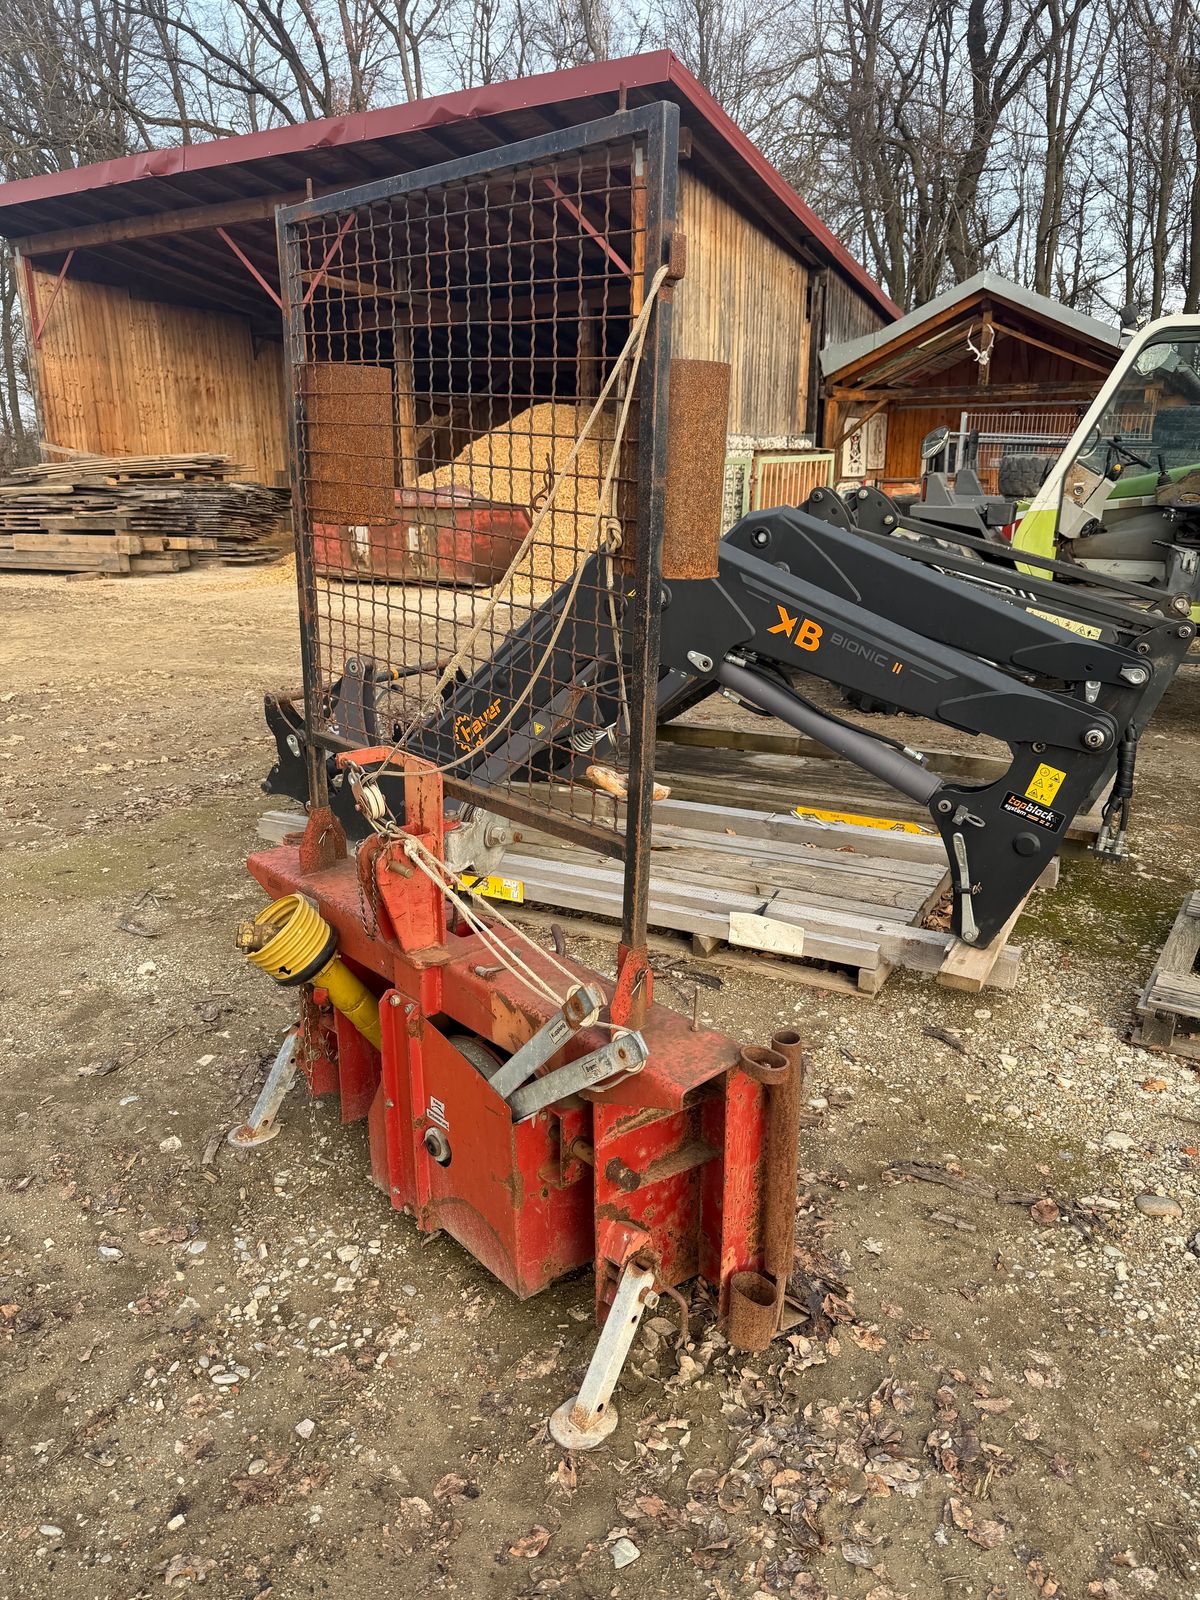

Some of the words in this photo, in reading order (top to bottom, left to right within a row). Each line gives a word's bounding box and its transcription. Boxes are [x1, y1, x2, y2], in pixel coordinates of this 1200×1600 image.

[766, 604, 824, 652] XB
[830, 633, 889, 667] BIONIC
[1004, 804, 1027, 816] system
[1008, 795, 1055, 821] topblock
